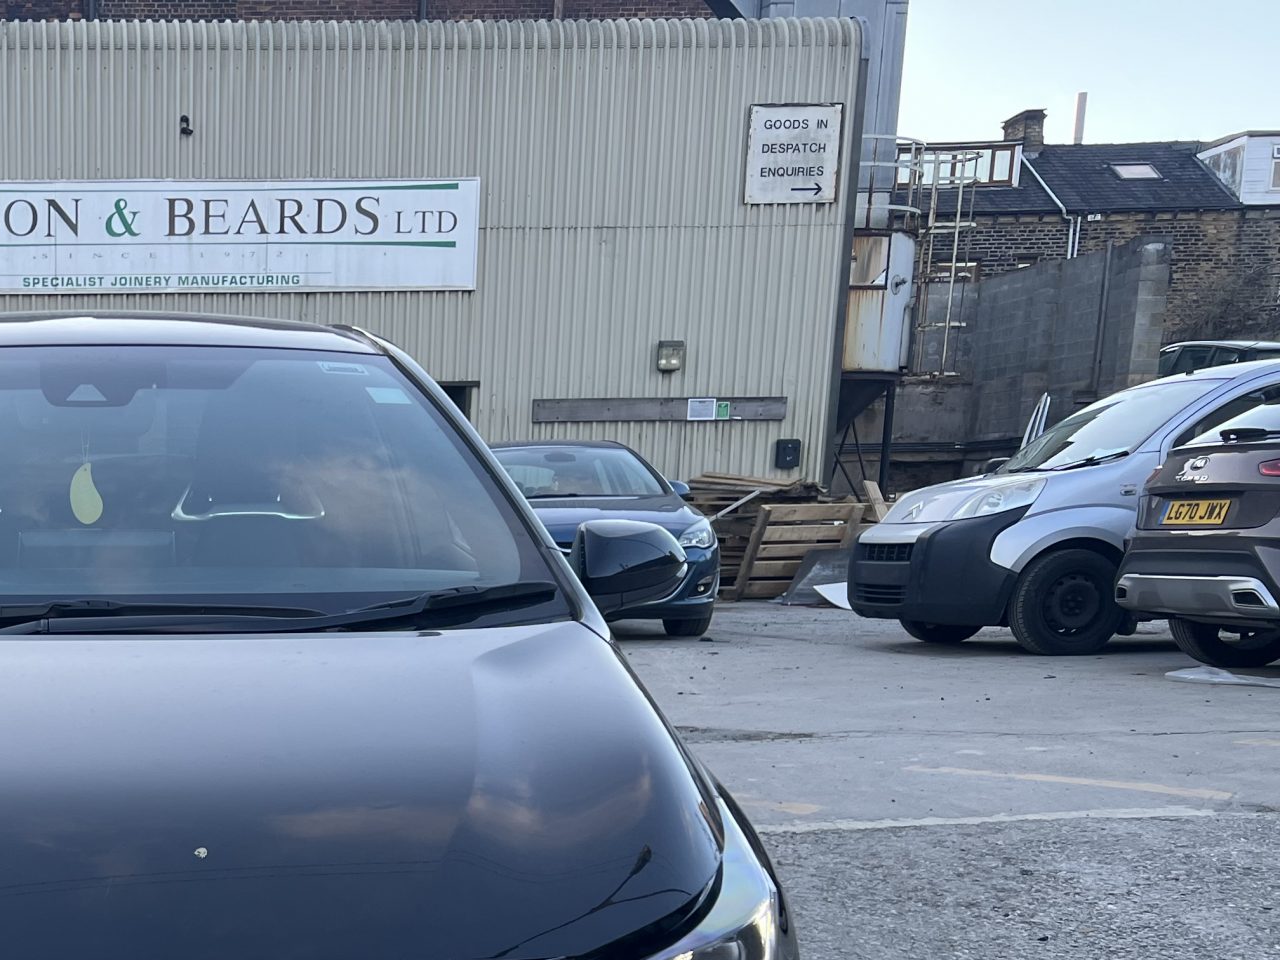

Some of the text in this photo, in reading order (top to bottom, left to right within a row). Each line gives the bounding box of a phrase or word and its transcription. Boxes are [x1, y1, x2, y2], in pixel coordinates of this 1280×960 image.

[764, 119, 829, 130] GOODS IN
[761, 142, 827, 154] DESPATCH
[759, 166, 825, 178] ENQUIRIES
[105, 197, 141, 238] &
[165, 196, 381, 237] BEARDS
[396, 210, 458, 234] LTD
[22, 274, 301, 288] SPECIALIST JOINERY MANUFACTURING
[1166, 502, 1227, 520] LG70 JWX
